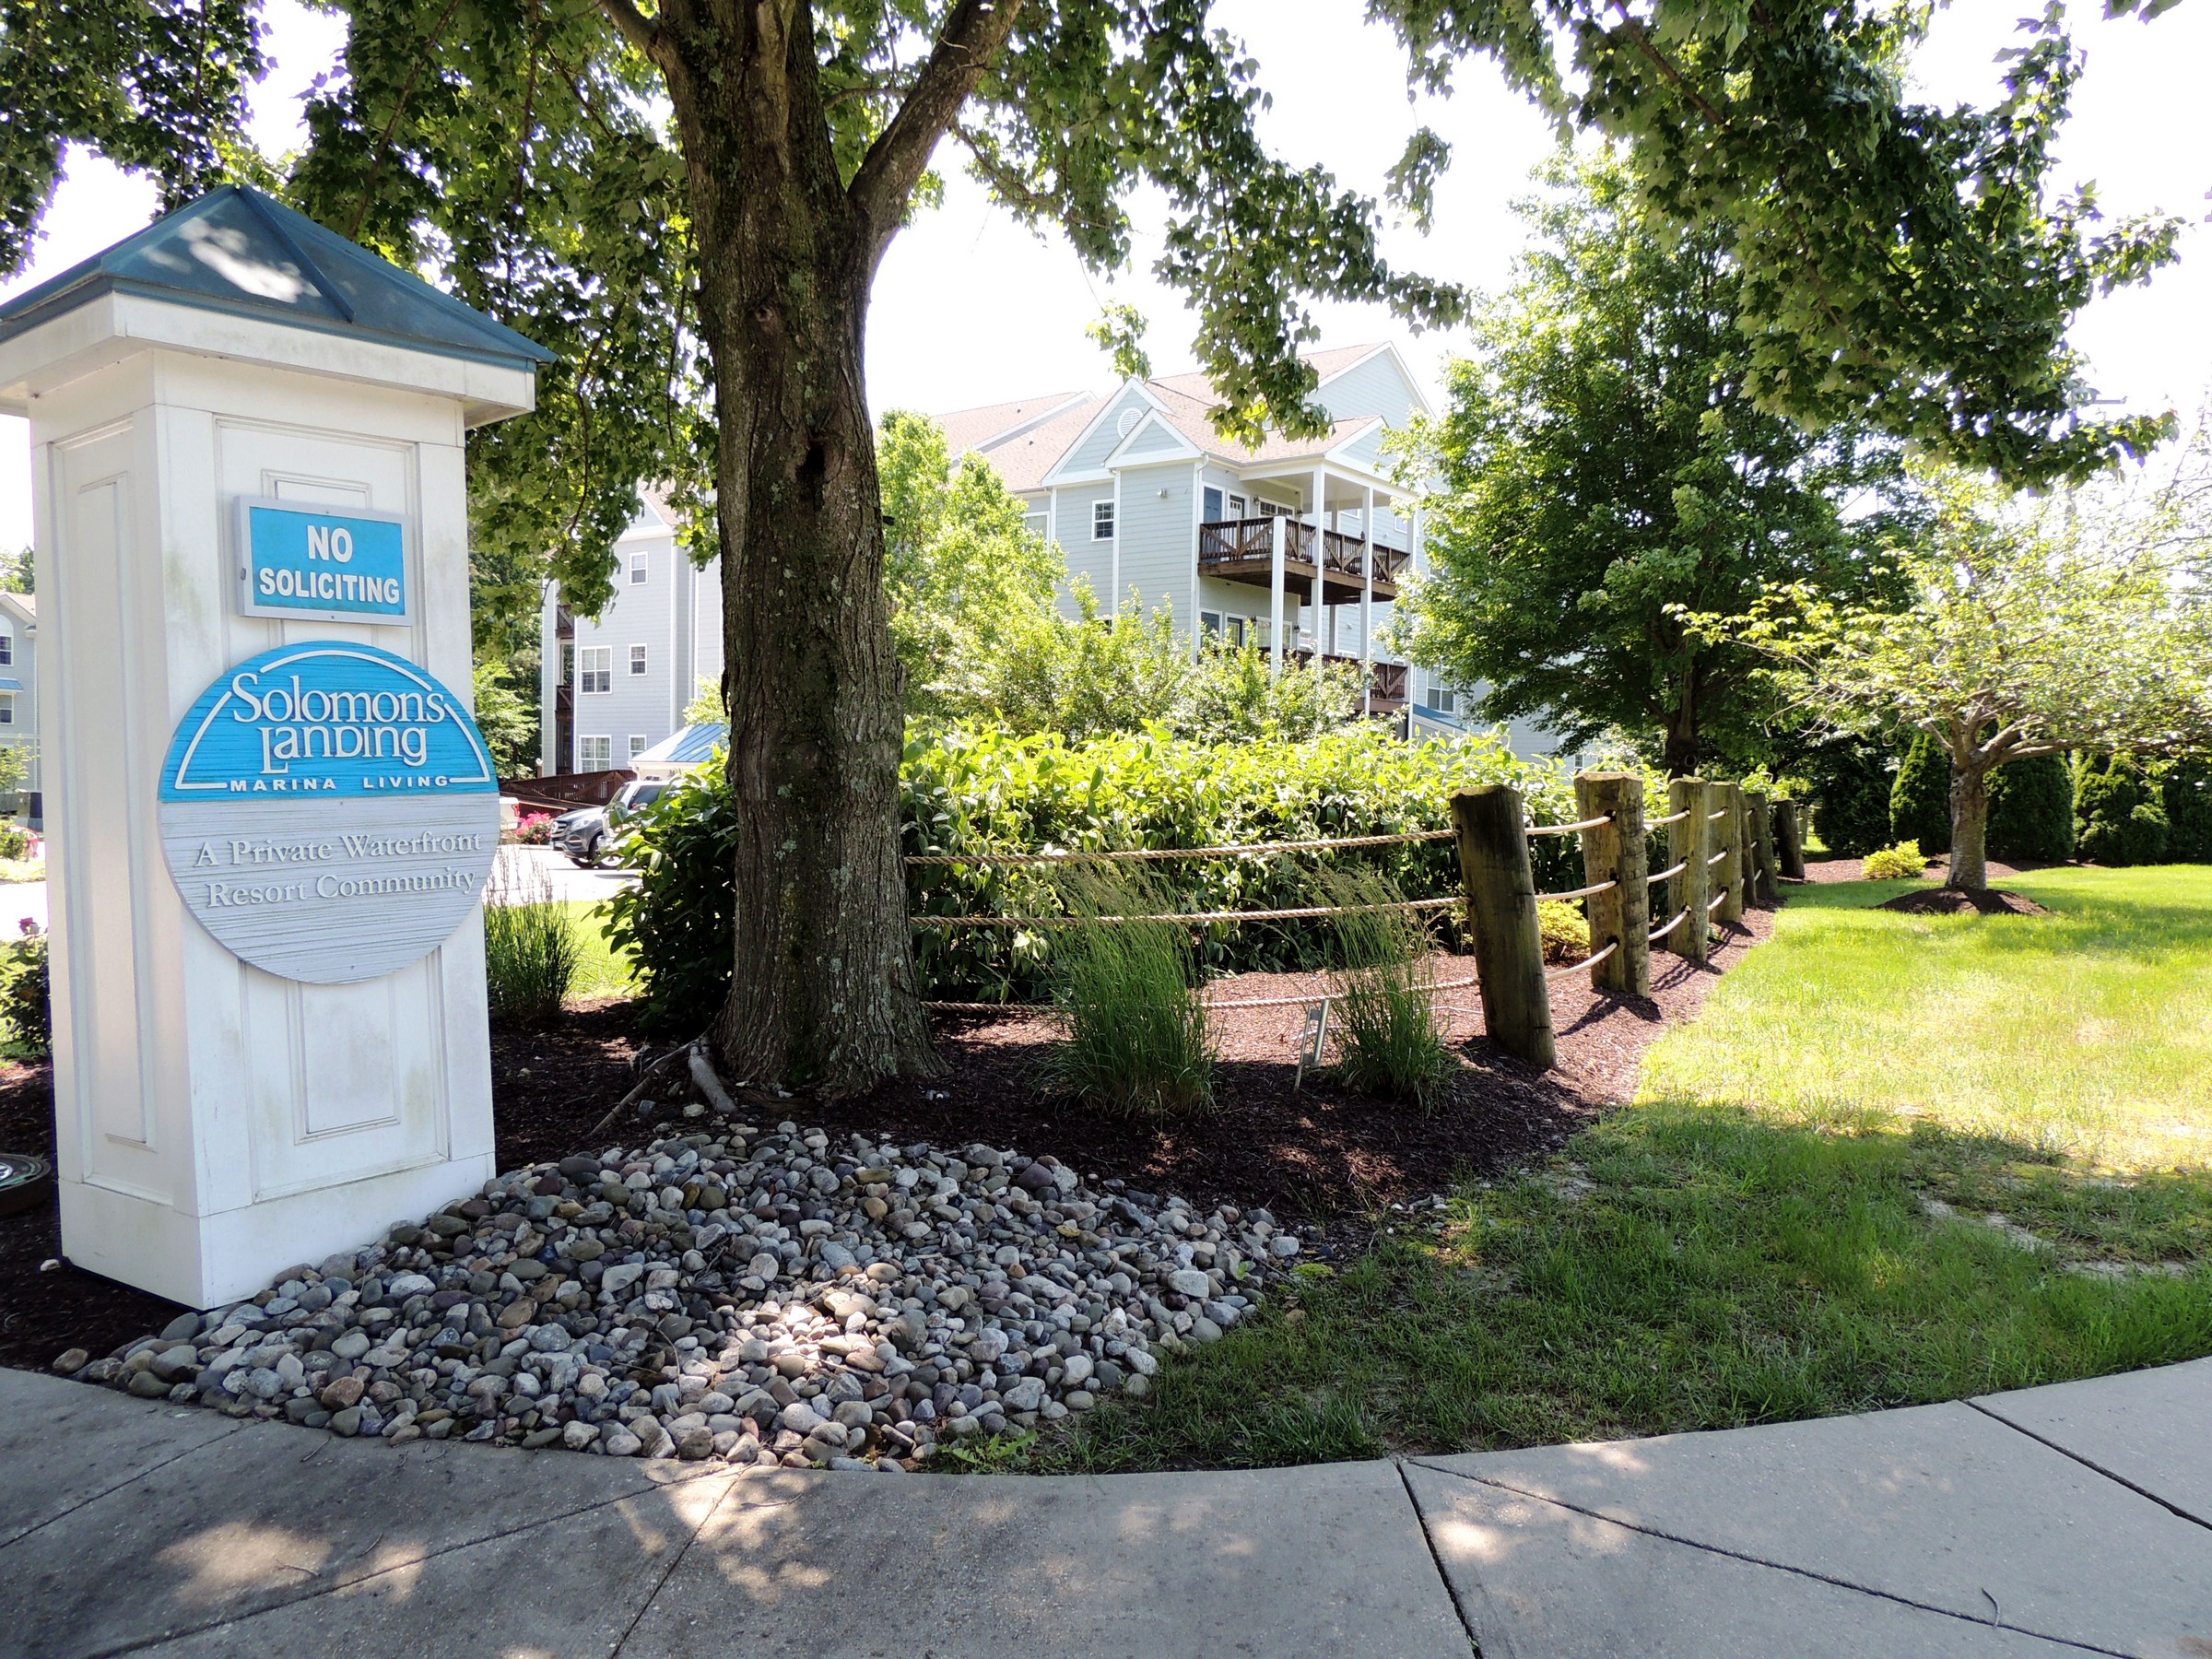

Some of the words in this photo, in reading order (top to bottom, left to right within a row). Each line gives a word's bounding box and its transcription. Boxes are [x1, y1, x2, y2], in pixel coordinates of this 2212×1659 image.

[307, 525, 353, 562] NO
[259, 567, 400, 604] SOLICITING
[232, 672, 444, 723] Solomons
[230, 778, 336, 792] MARINA
[362, 775, 449, 788] LIVING
[194, 843, 219, 867] A
[229, 838, 333, 866] Private
[341, 831, 482, 859] Waterfront
[207, 880, 308, 908] Resort
[316, 865, 476, 898] Community
